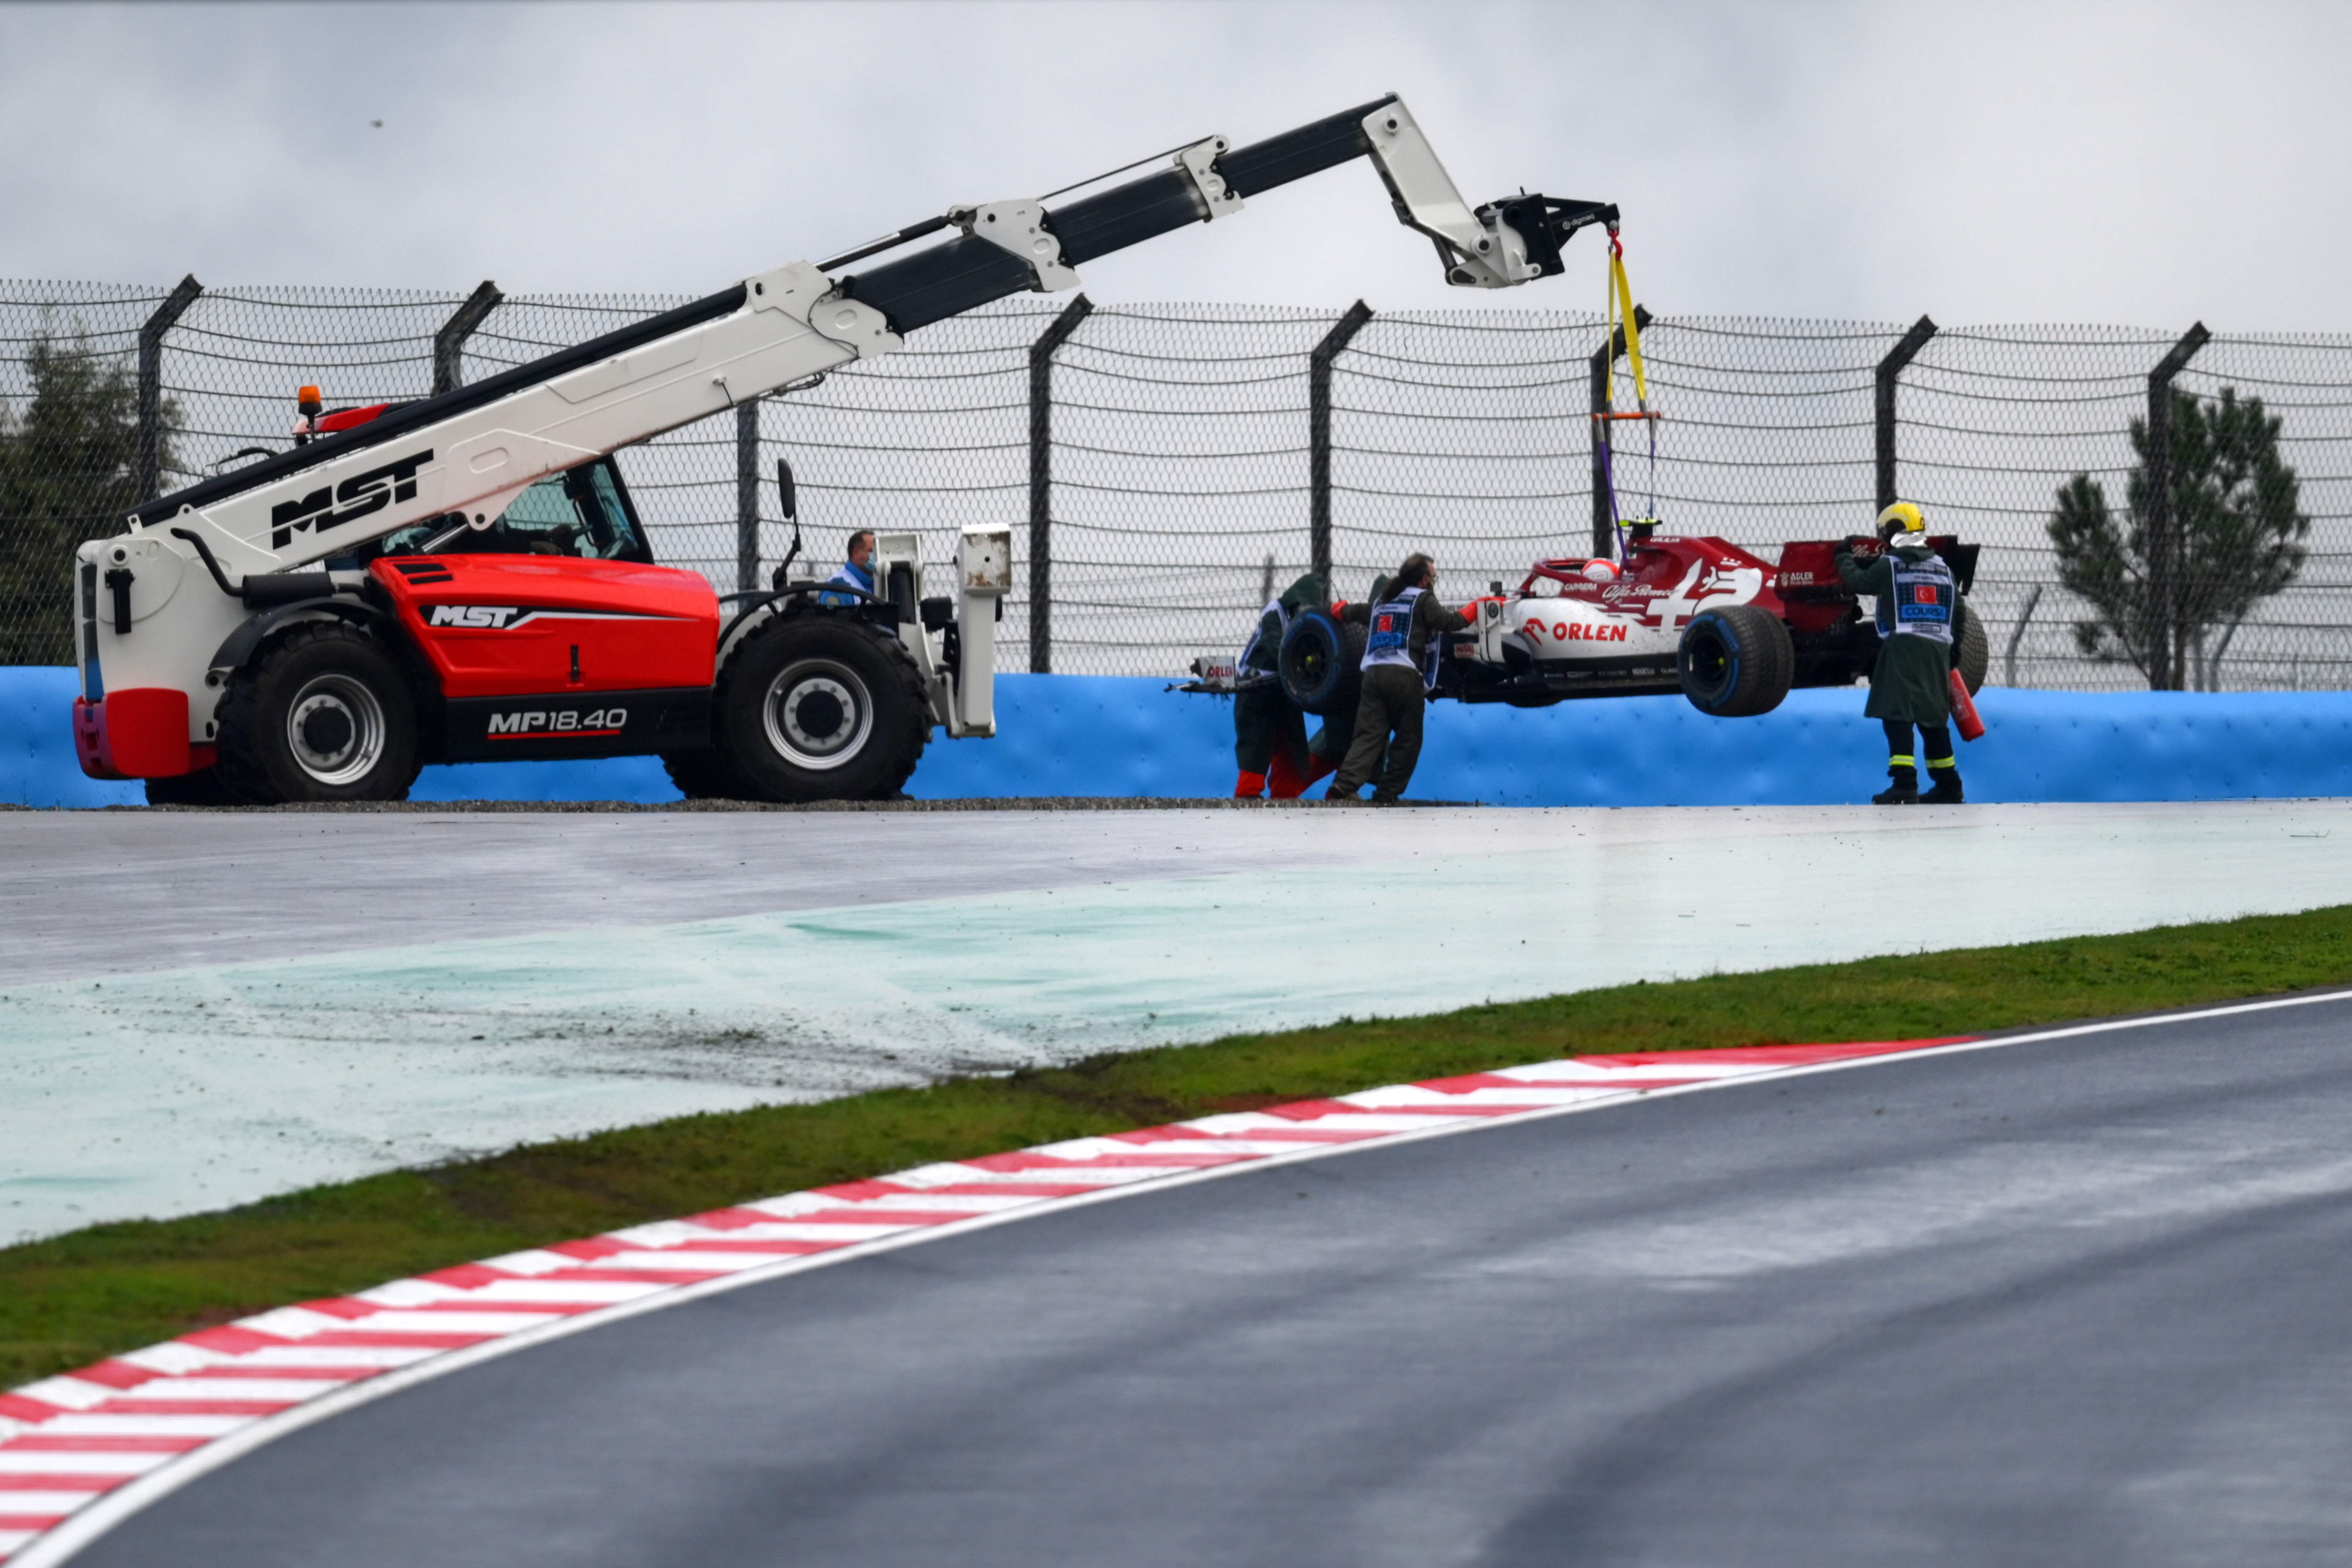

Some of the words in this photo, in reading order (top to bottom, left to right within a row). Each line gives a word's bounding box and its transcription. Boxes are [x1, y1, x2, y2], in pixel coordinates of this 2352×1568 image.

[272, 448, 434, 550] MST
[1790, 572, 1813, 580] ADLER
[1564, 583, 1597, 591] CARRERA
[430, 605, 518, 628] MST
[1553, 621, 1628, 641] ORLEN
